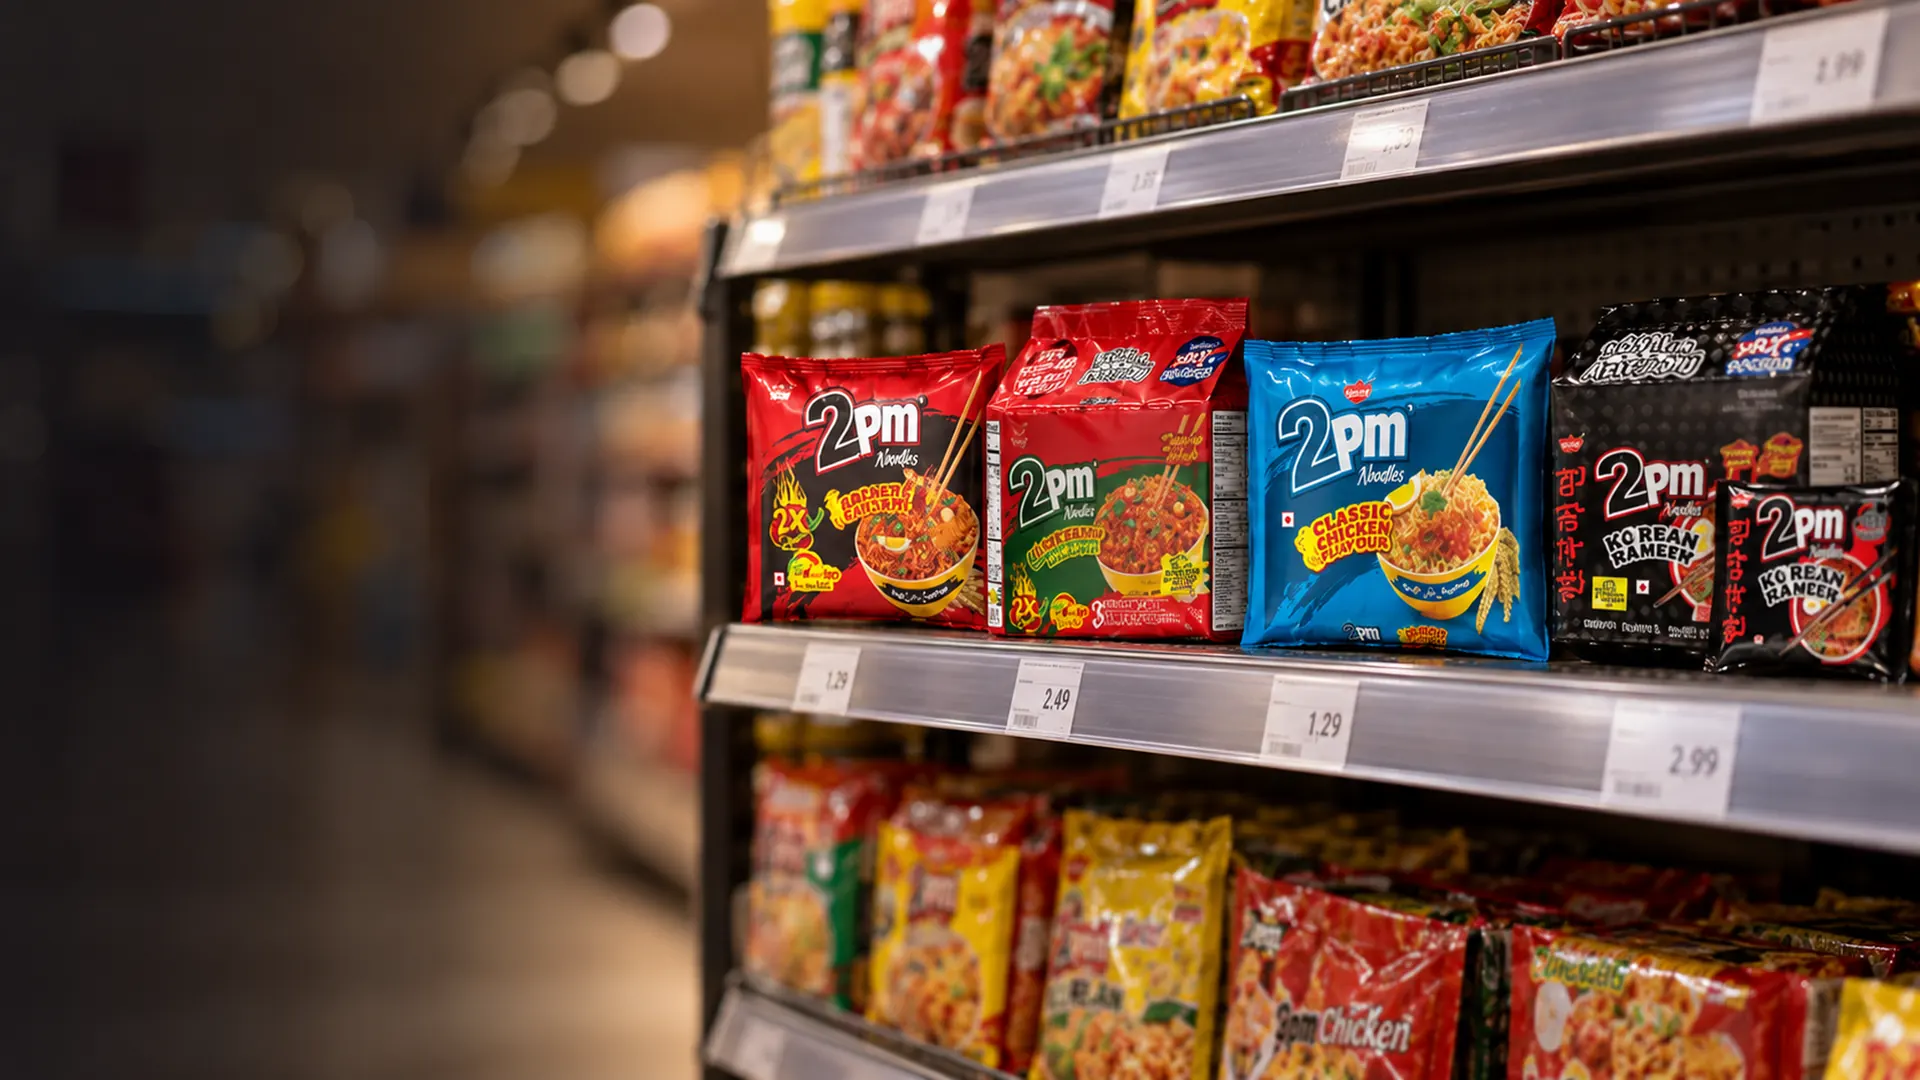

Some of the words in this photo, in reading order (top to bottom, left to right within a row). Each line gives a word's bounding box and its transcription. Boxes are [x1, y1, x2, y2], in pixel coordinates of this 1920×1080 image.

[804, 389, 919, 474] 2pm
[1277, 398, 1407, 493] 2pm
[1356, 463, 1405, 486] Noodles
[1596, 449, 1705, 519] 2pm
[1008, 456, 1096, 529] 2pm
[772, 507, 808, 534] 2X
[1312, 504, 1392, 537] CLASSIC
[1316, 520, 1391, 551] CHICKEN
[1756, 494, 1845, 561] 2pm
[1011, 597, 1037, 617] 2X
[1342, 623, 1381, 641] 2pm
[1042, 688, 1071, 711] 2.49
[1319, 1005, 1412, 1053] Chicken
